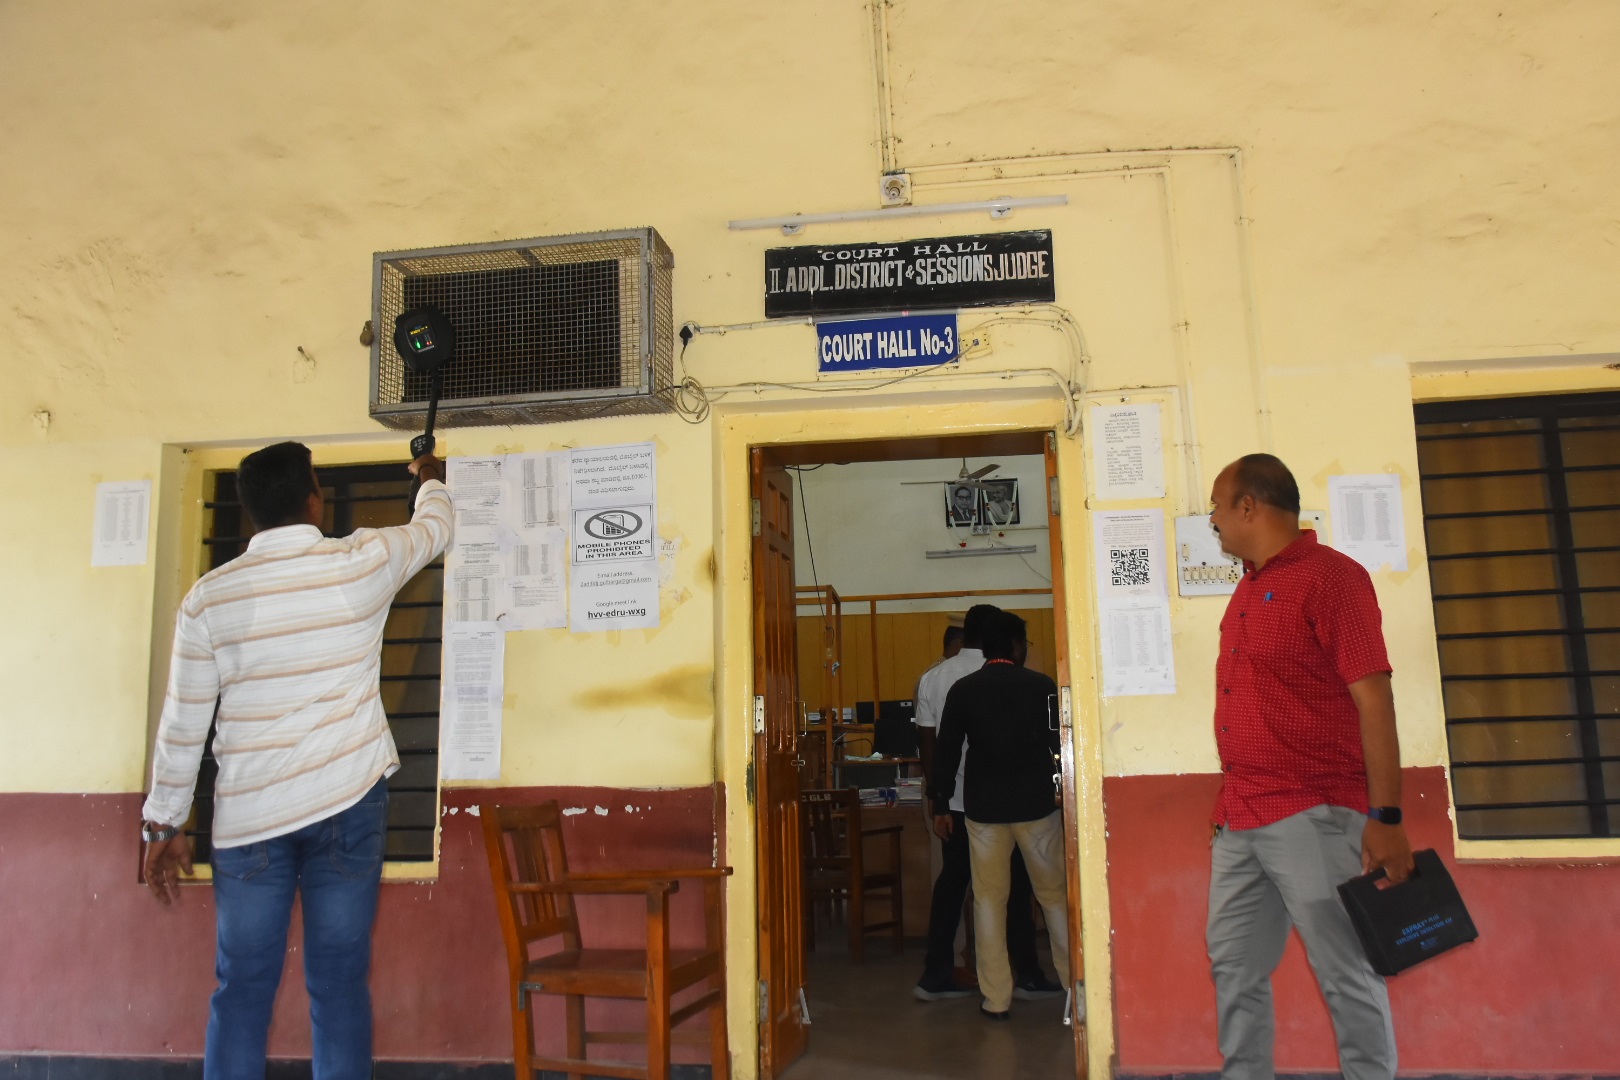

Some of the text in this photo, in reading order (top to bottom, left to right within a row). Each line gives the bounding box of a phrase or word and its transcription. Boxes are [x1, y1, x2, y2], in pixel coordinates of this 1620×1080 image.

[821, 241, 988, 261] COURT HALL
[834, 259, 906, 290] DISTRICT
[905, 264, 915, 280] &
[822, 326, 954, 363] COURT HALL No-3
[588, 608, 646, 618] hvv-edru-wxg
